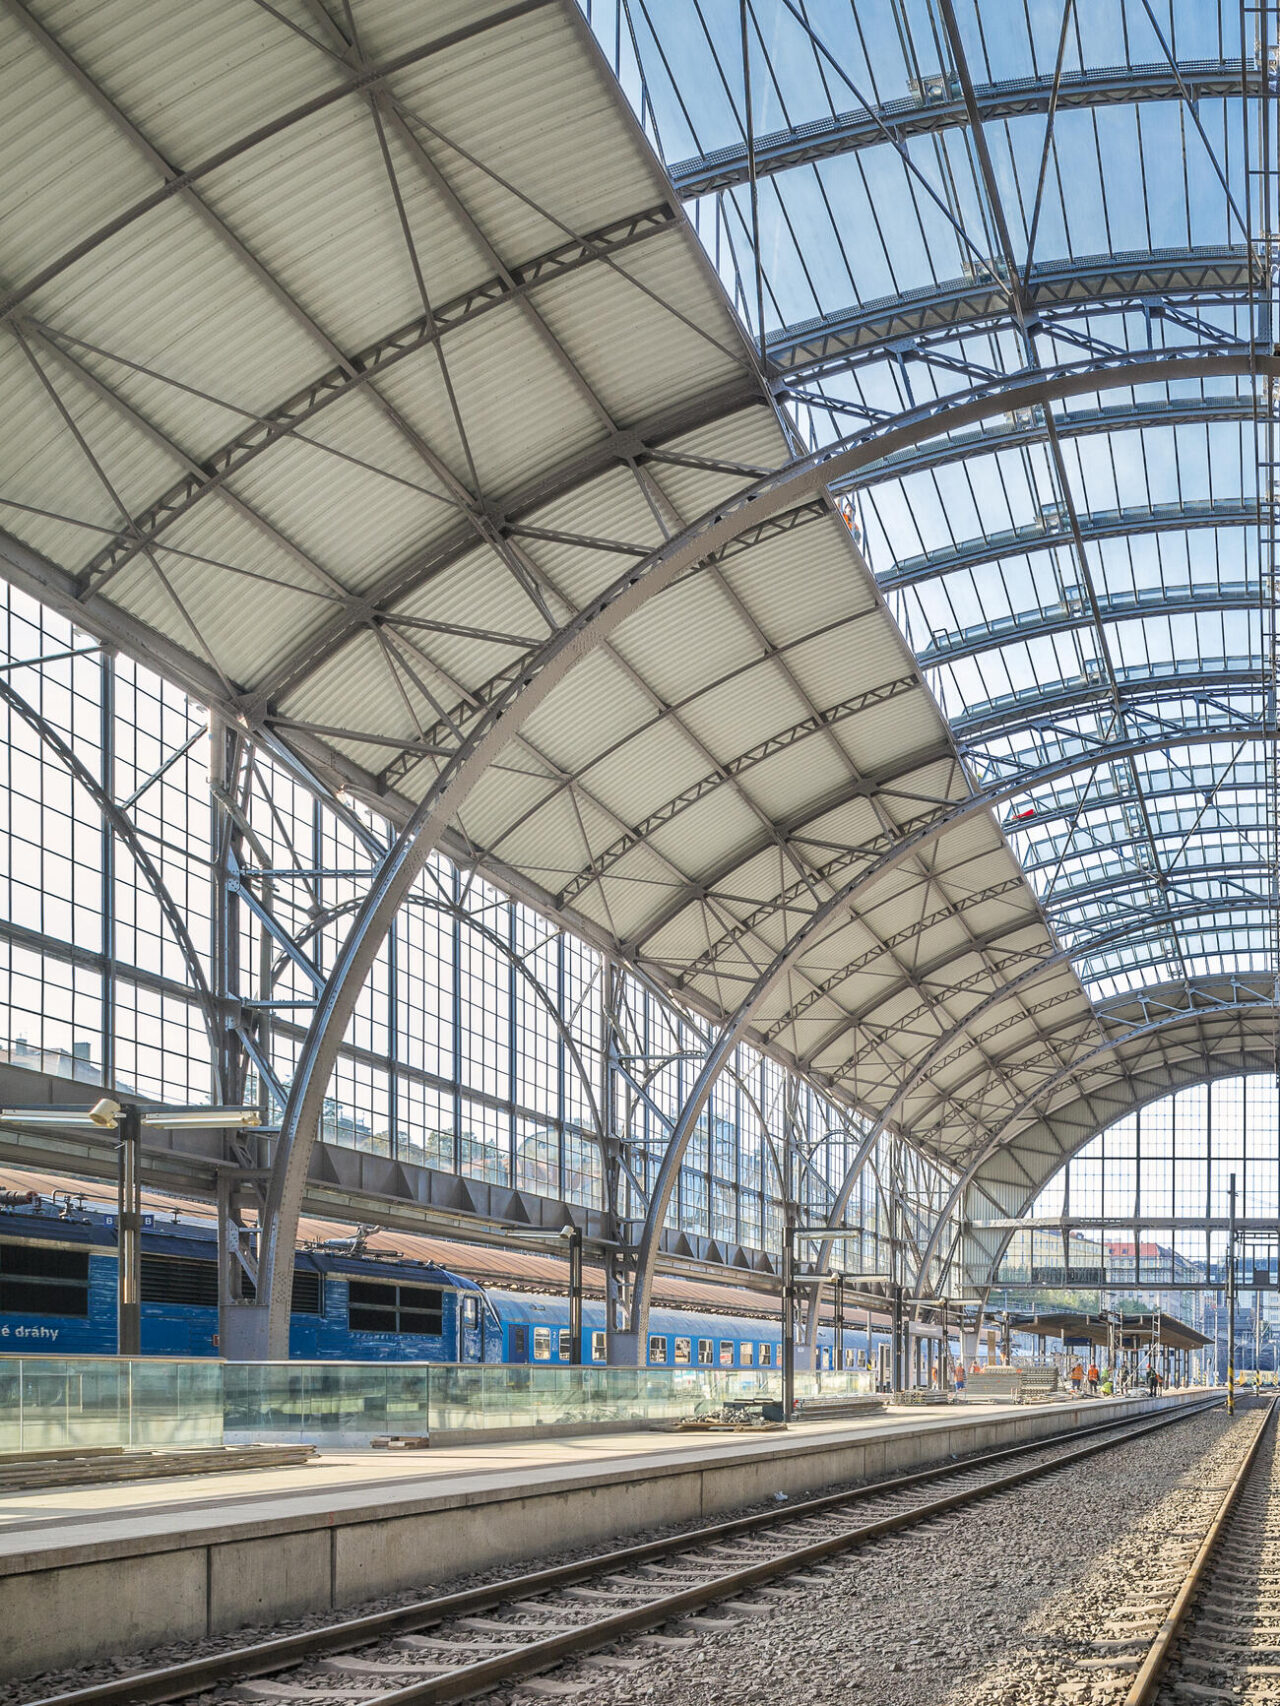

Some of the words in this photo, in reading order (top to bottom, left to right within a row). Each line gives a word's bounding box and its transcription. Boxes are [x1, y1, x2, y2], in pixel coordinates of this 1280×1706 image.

[106, 1217, 113, 1225] B
[145, 1217, 152, 1225] B
[15, 1325, 59, 1341] dráhy
